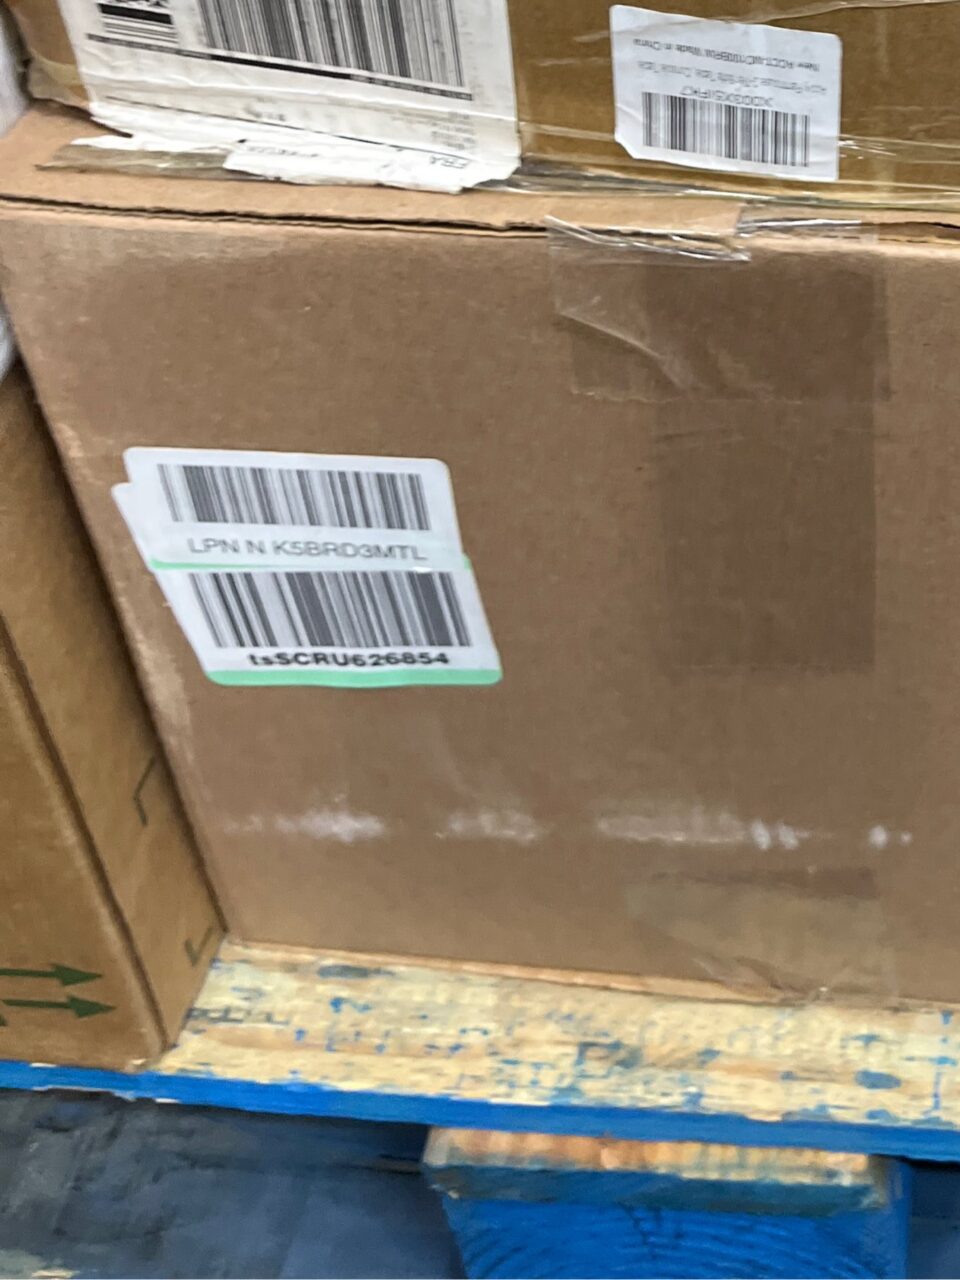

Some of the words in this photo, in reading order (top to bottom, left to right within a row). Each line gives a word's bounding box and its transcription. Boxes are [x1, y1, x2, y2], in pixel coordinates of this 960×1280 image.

[187, 538, 240, 555] LPN
[247, 539, 267, 555] N
[248, 651, 451, 667] tsSCRU626854
